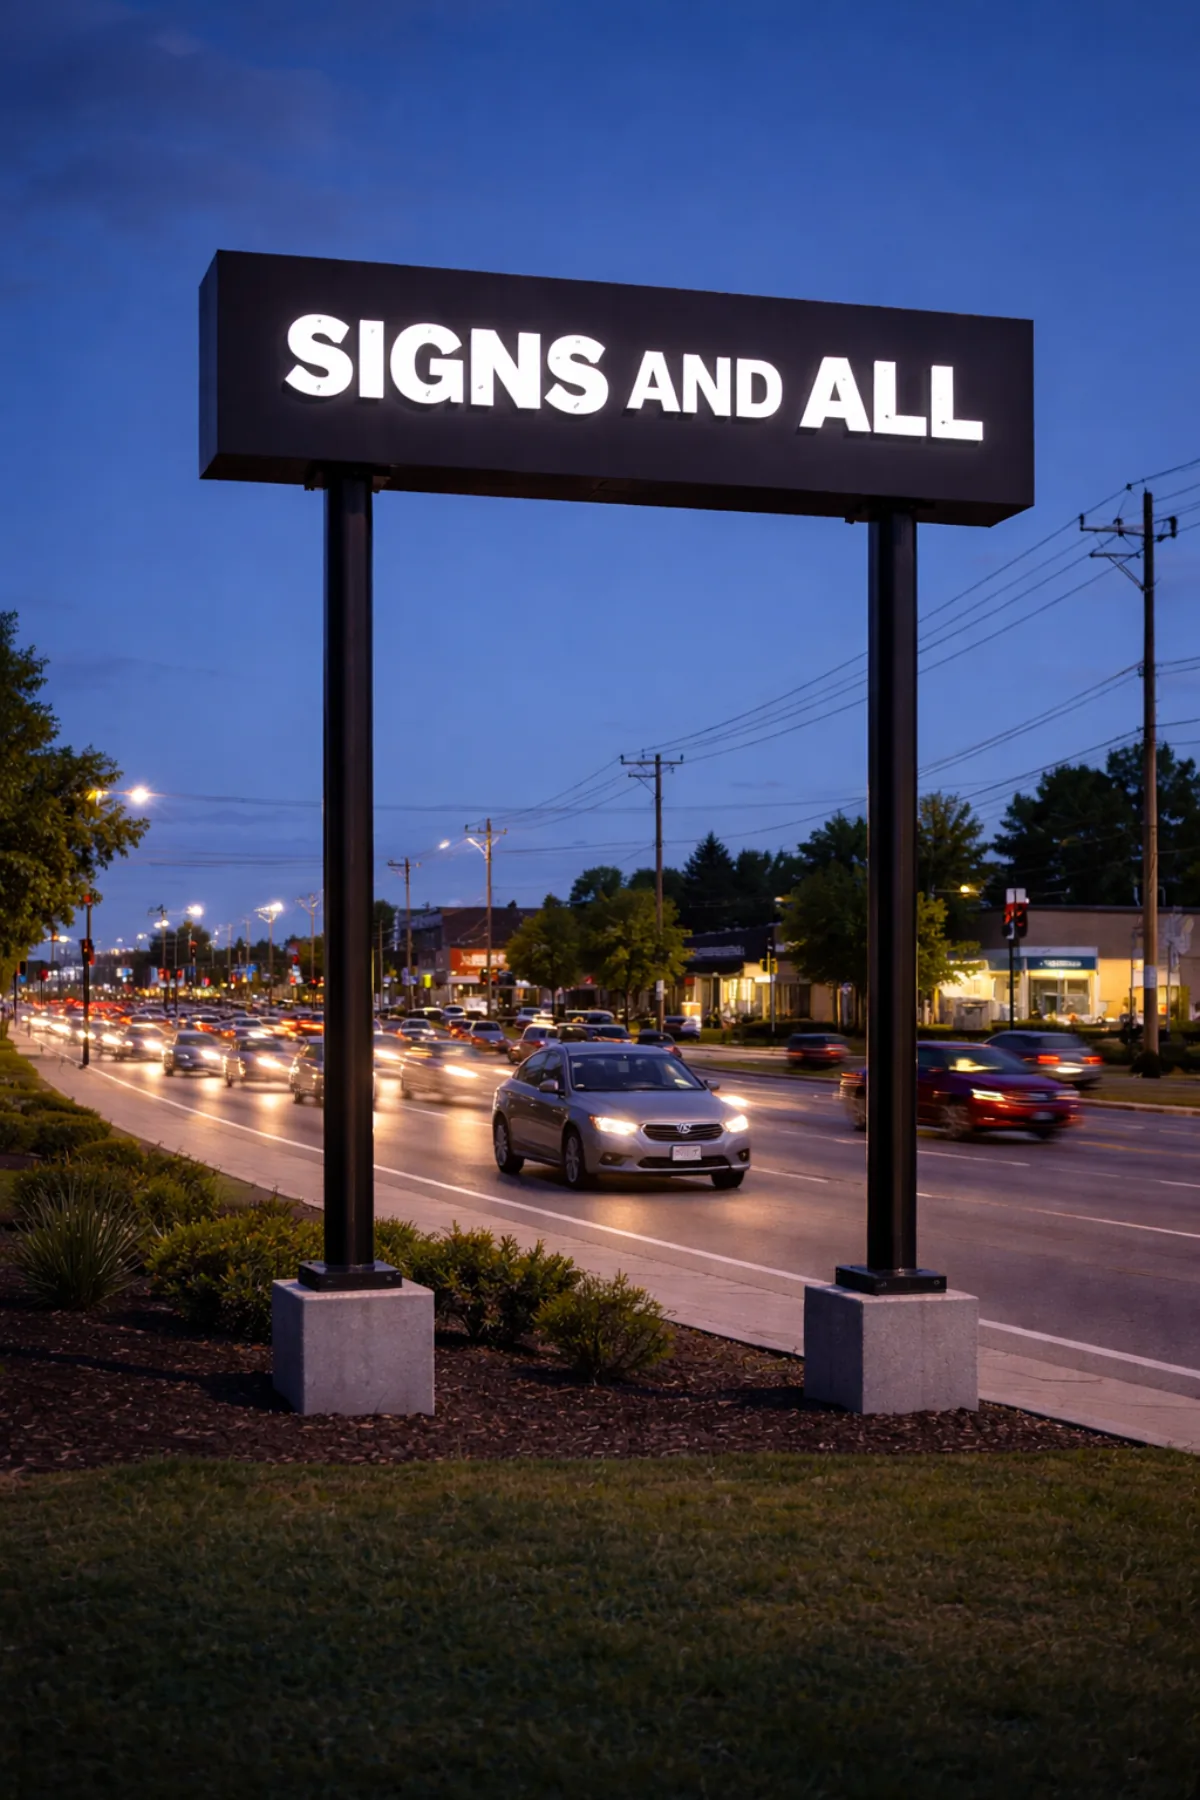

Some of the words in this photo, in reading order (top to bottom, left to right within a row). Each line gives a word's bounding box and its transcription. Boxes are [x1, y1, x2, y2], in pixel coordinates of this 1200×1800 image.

[285, 313, 608, 415] SIGNS
[626, 350, 783, 419] AND
[799, 356, 984, 442] ALL
